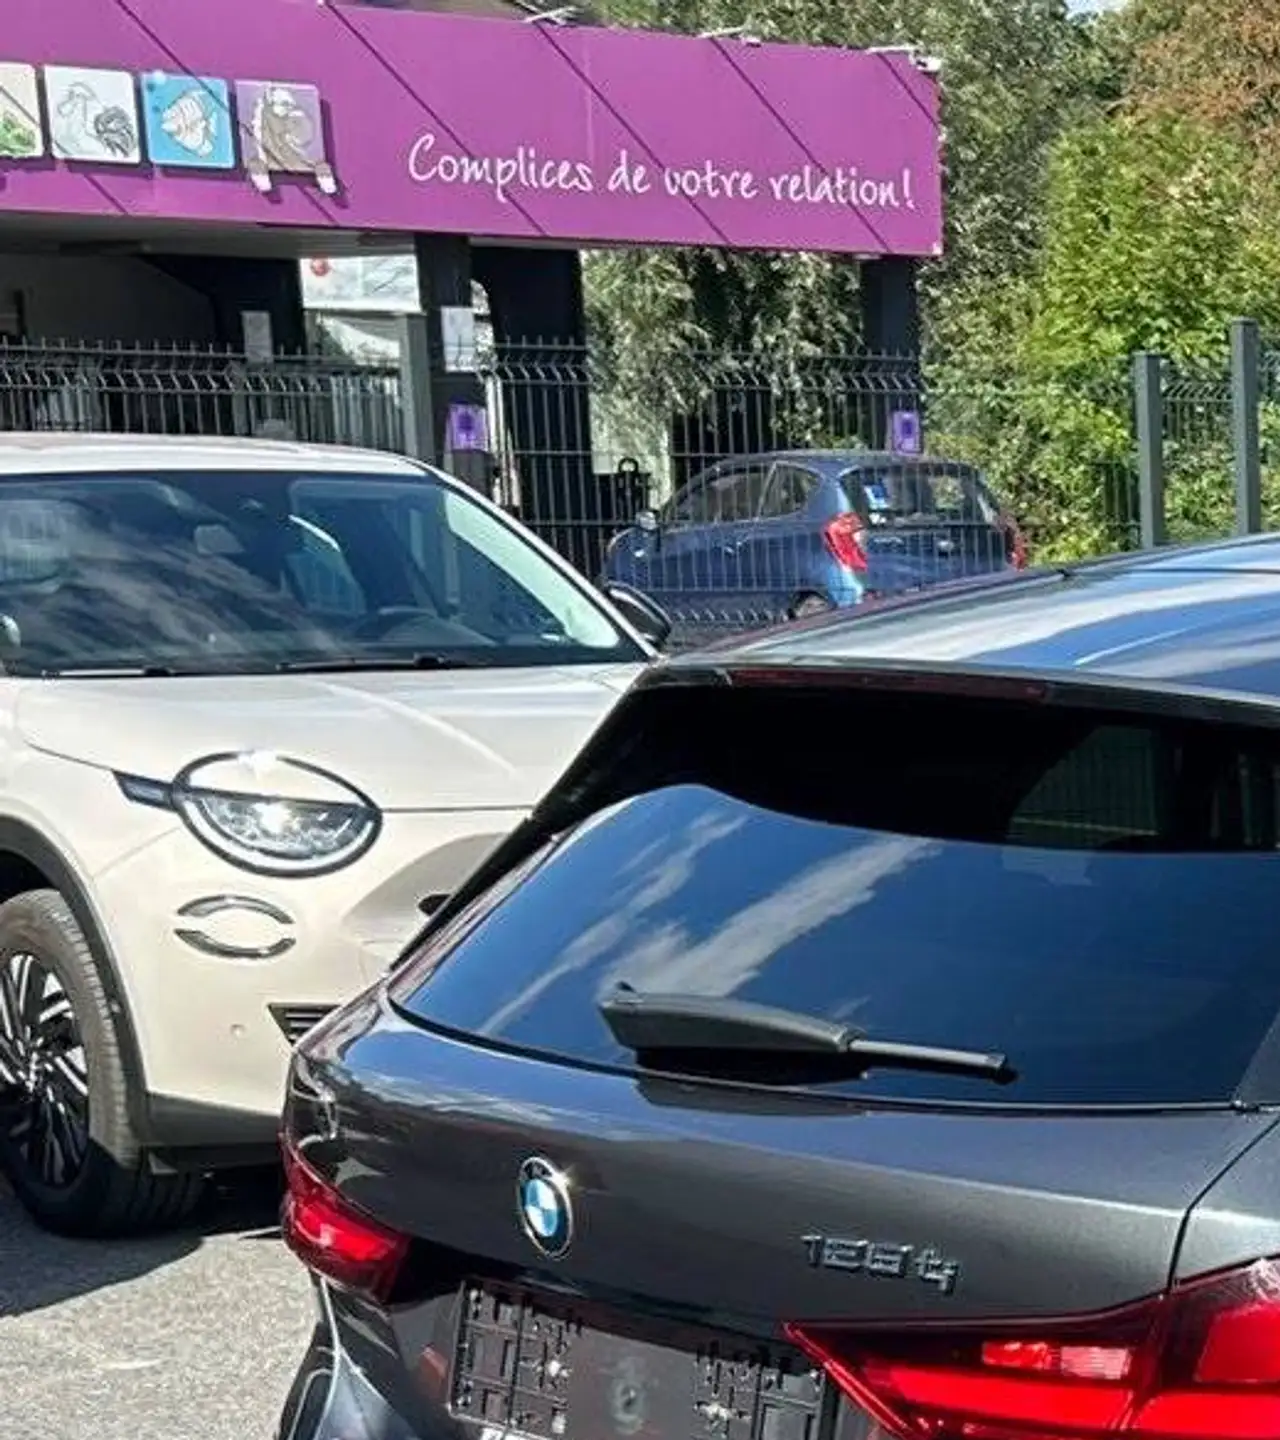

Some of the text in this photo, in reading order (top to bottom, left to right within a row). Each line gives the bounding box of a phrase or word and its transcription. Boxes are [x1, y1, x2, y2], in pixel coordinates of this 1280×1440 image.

[407, 133, 915, 209] Complices de votre relation!
